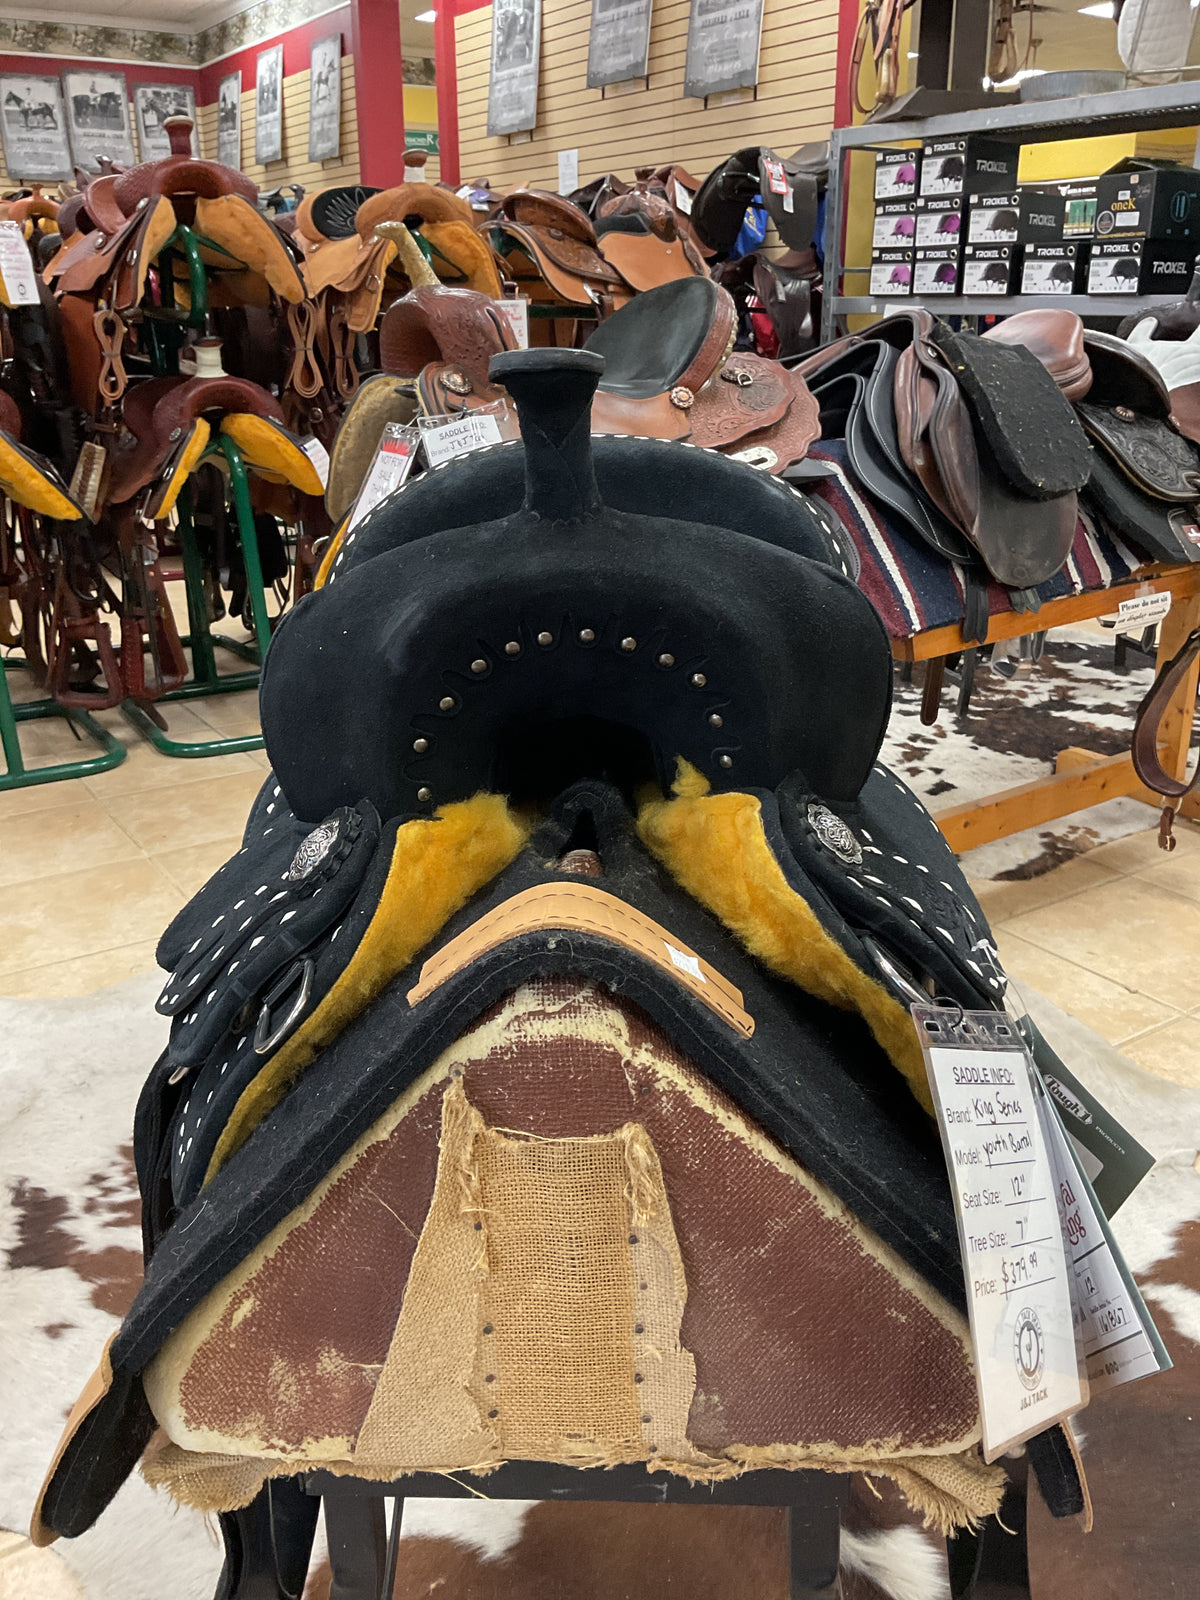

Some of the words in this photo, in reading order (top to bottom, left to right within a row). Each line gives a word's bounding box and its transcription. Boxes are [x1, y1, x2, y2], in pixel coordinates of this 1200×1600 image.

[976, 159, 1008, 173] TROXEL
[982, 197, 1009, 206] TROXEL
[1111, 198, 1136, 211] oneK
[1028, 213, 1056, 227] TROXEL
[975, 250, 999, 258] TROXEL
[1037, 248, 1065, 256] TROXEL
[1103, 244, 1130, 253] TROXEL
[1152, 261, 1187, 274] TROXEL
[439, 425, 470, 440] SADDLE
[1121, 602, 1140, 612] Please
[952, 1066, 990, 1083] SADDLE
[989, 1067, 1015, 1083] INFO:
[1046, 1075, 1082, 1116] Tough
[1080, 1110, 1091, 1122] 1
[945, 1107, 973, 1124] Brand:
[972, 1098, 997, 1125] King
[995, 1091, 1022, 1117] Series
[954, 1148, 982, 1165] Model:
[962, 1191, 982, 1209] Seat
[982, 1188, 1002, 1205] Size:
[968, 1235, 988, 1253] Tree
[988, 1231, 1008, 1248] Size:
[974, 1277, 998, 1298] Price:
[1020, 1394, 1031, 1411] J&J
[1031, 1388, 1048, 1405] TACK
